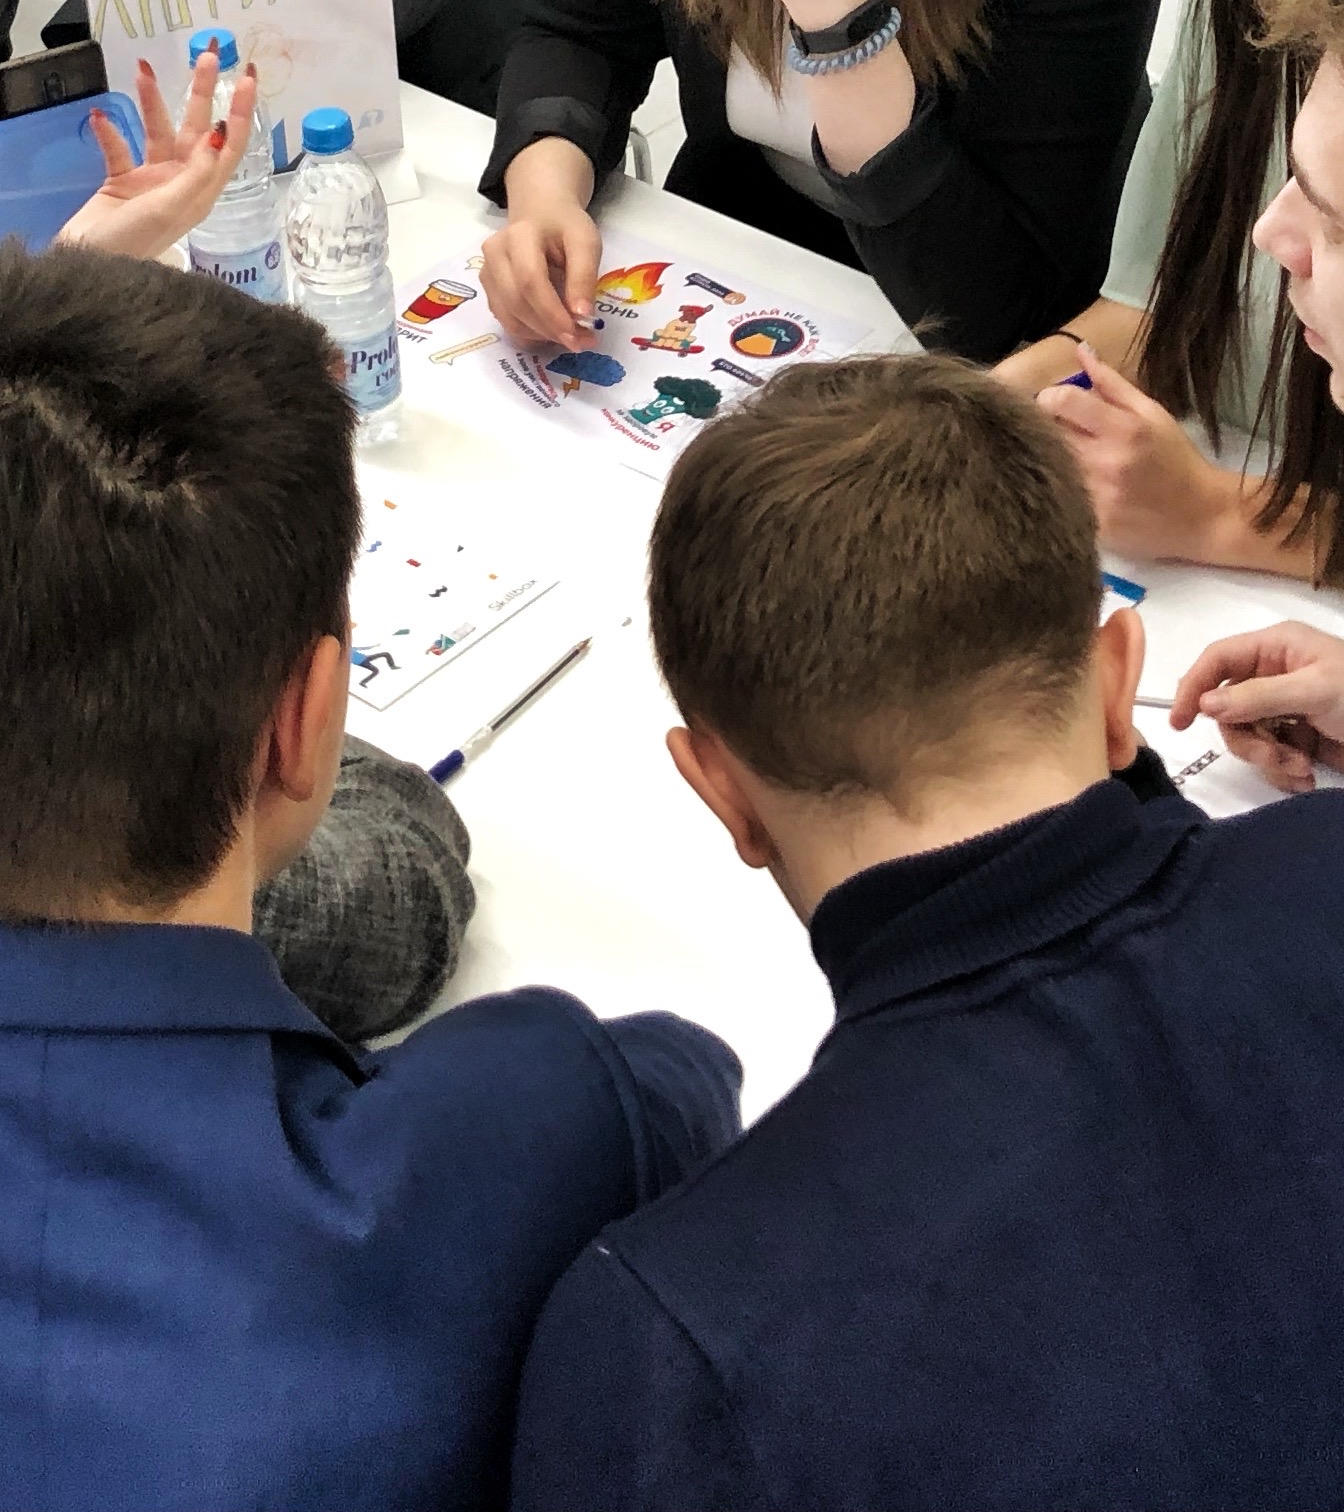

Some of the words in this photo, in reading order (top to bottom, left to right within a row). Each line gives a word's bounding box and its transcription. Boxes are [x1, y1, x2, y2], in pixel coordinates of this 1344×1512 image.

[594, 300, 640, 319] ГОНЬ
[727, 308, 780, 328] ДУМАЙ
[783, 311, 804, 322] НЕ
[497, 358, 552, 409] напряжения
[655, 421, 676, 434] Я
[487, 578, 538, 612] Skillbox
